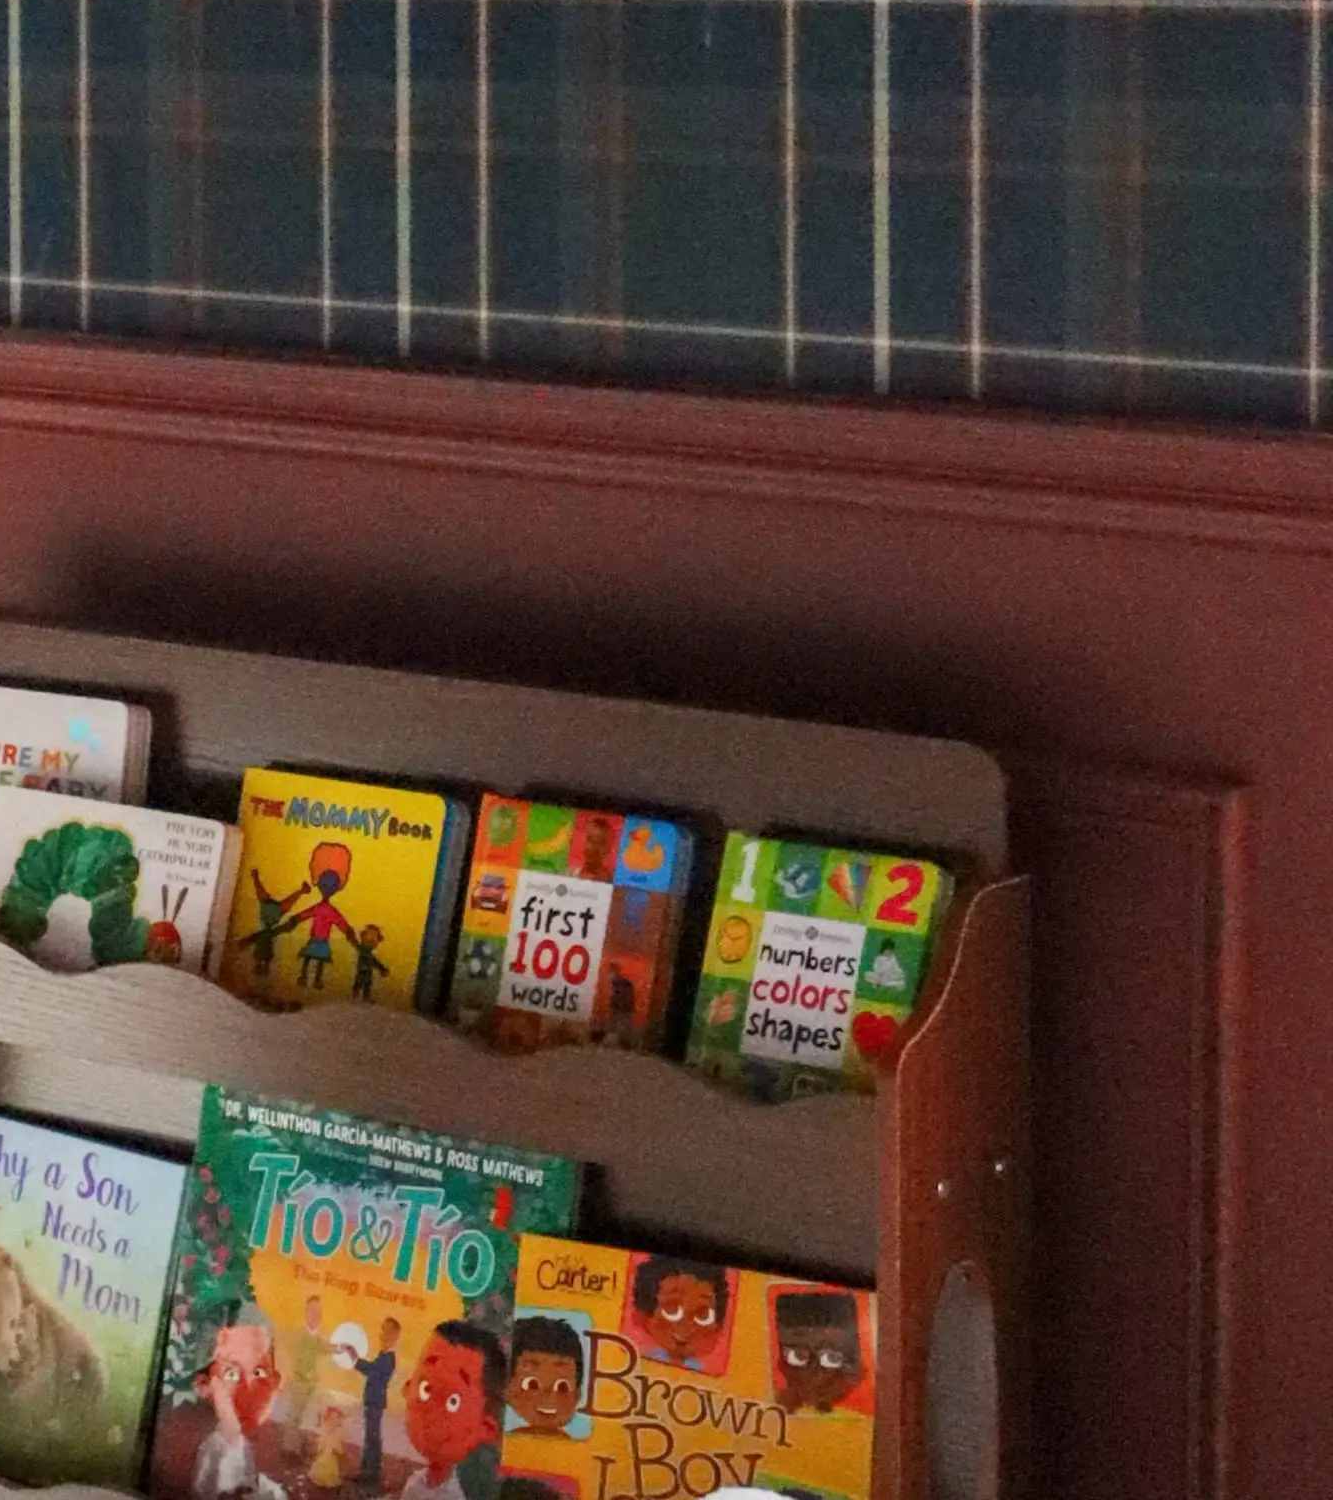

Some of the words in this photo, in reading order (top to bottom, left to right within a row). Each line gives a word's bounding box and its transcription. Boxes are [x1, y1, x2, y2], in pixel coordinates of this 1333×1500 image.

[40, 749, 81, 774] MY
[250, 796, 285, 819] THE
[285, 796, 390, 839] MOMMY
[388, 816, 433, 840] BOOK
[731, 840, 761, 903] 1
[876, 863, 925, 926] 2
[521, 896, 595, 939] first
[510, 931, 590, 985] 100
[760, 944, 858, 977] numbers
[511, 984, 579, 1012] words
[752, 974, 852, 1015] colors
[746, 1008, 844, 1054] shapes
[225, 1100, 244, 1119] DR.
[248, 1104, 322, 1136] WELLINTHON
[447, 1149, 480, 1173] ROSS
[482, 1158, 545, 1187] MATHEWS
[44, 1162, 67, 1191] a
[76, 1152, 141, 1215] Son
[40, 1201, 107, 1253] Needs
[114, 1237, 132, 1259] a
[57, 1253, 148, 1325] Mom
[577, 1330, 793, 1447] Brown
